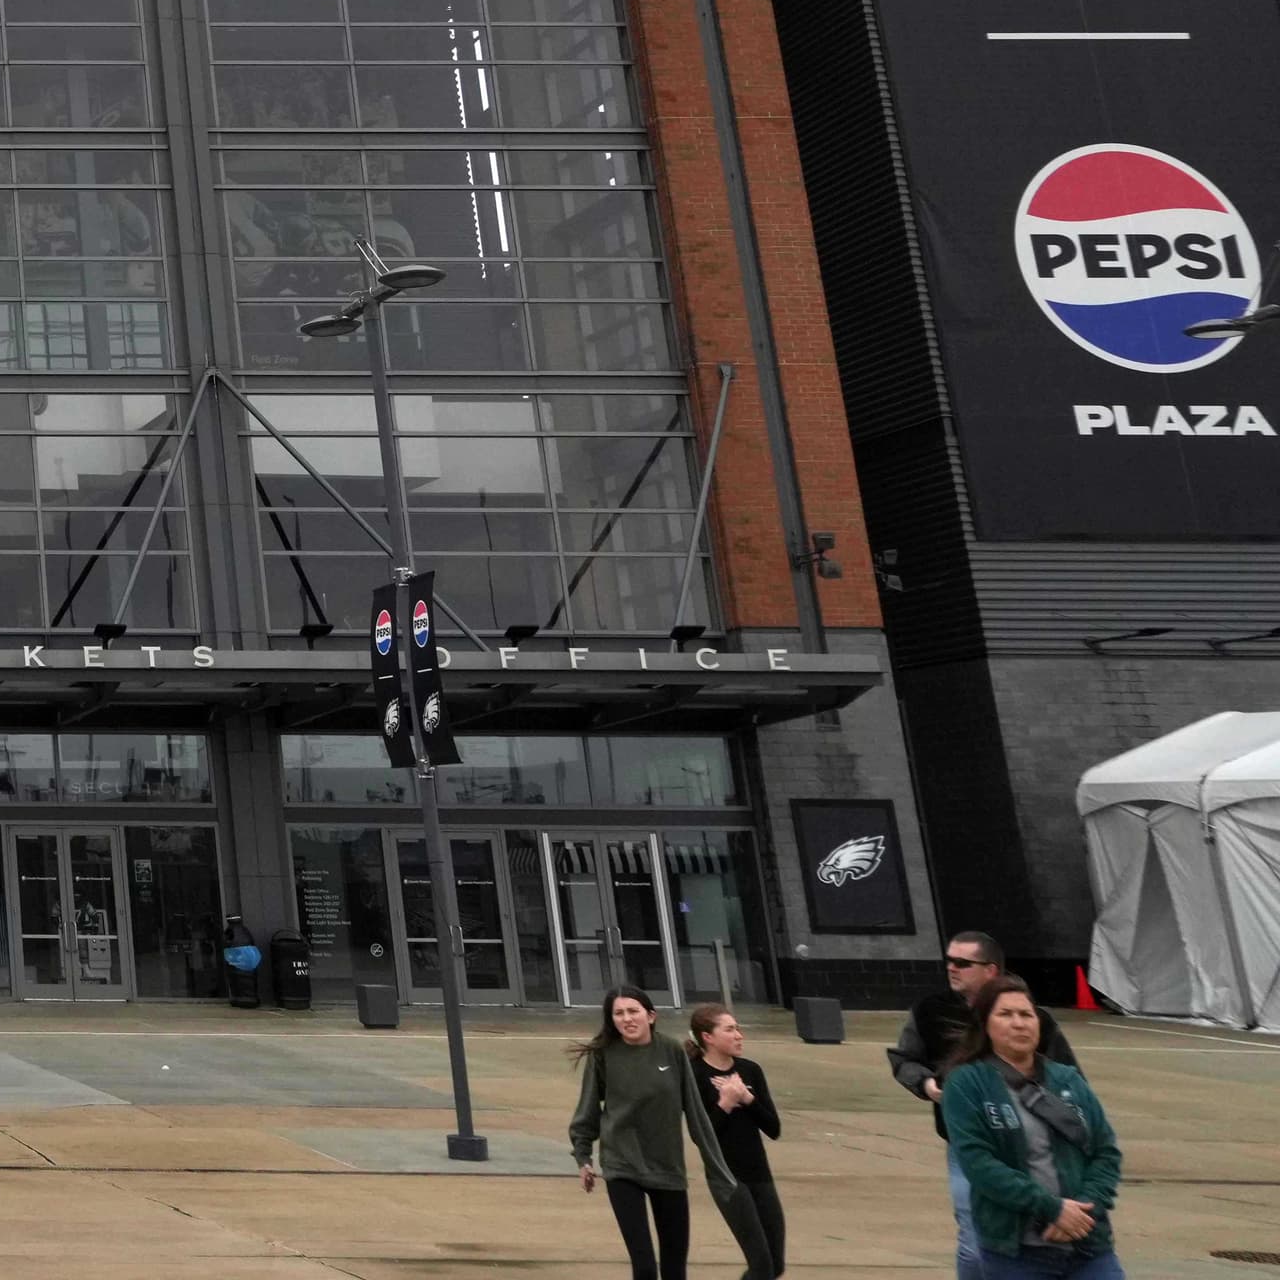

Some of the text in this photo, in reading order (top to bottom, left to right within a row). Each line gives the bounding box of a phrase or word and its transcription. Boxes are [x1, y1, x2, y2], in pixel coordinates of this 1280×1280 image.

[1030, 233, 1246, 280] PEPSI
[1073, 404, 1278, 435] PLAZA
[377, 627, 391, 638] PEPSI
[414, 618, 428, 629] PEPSI
